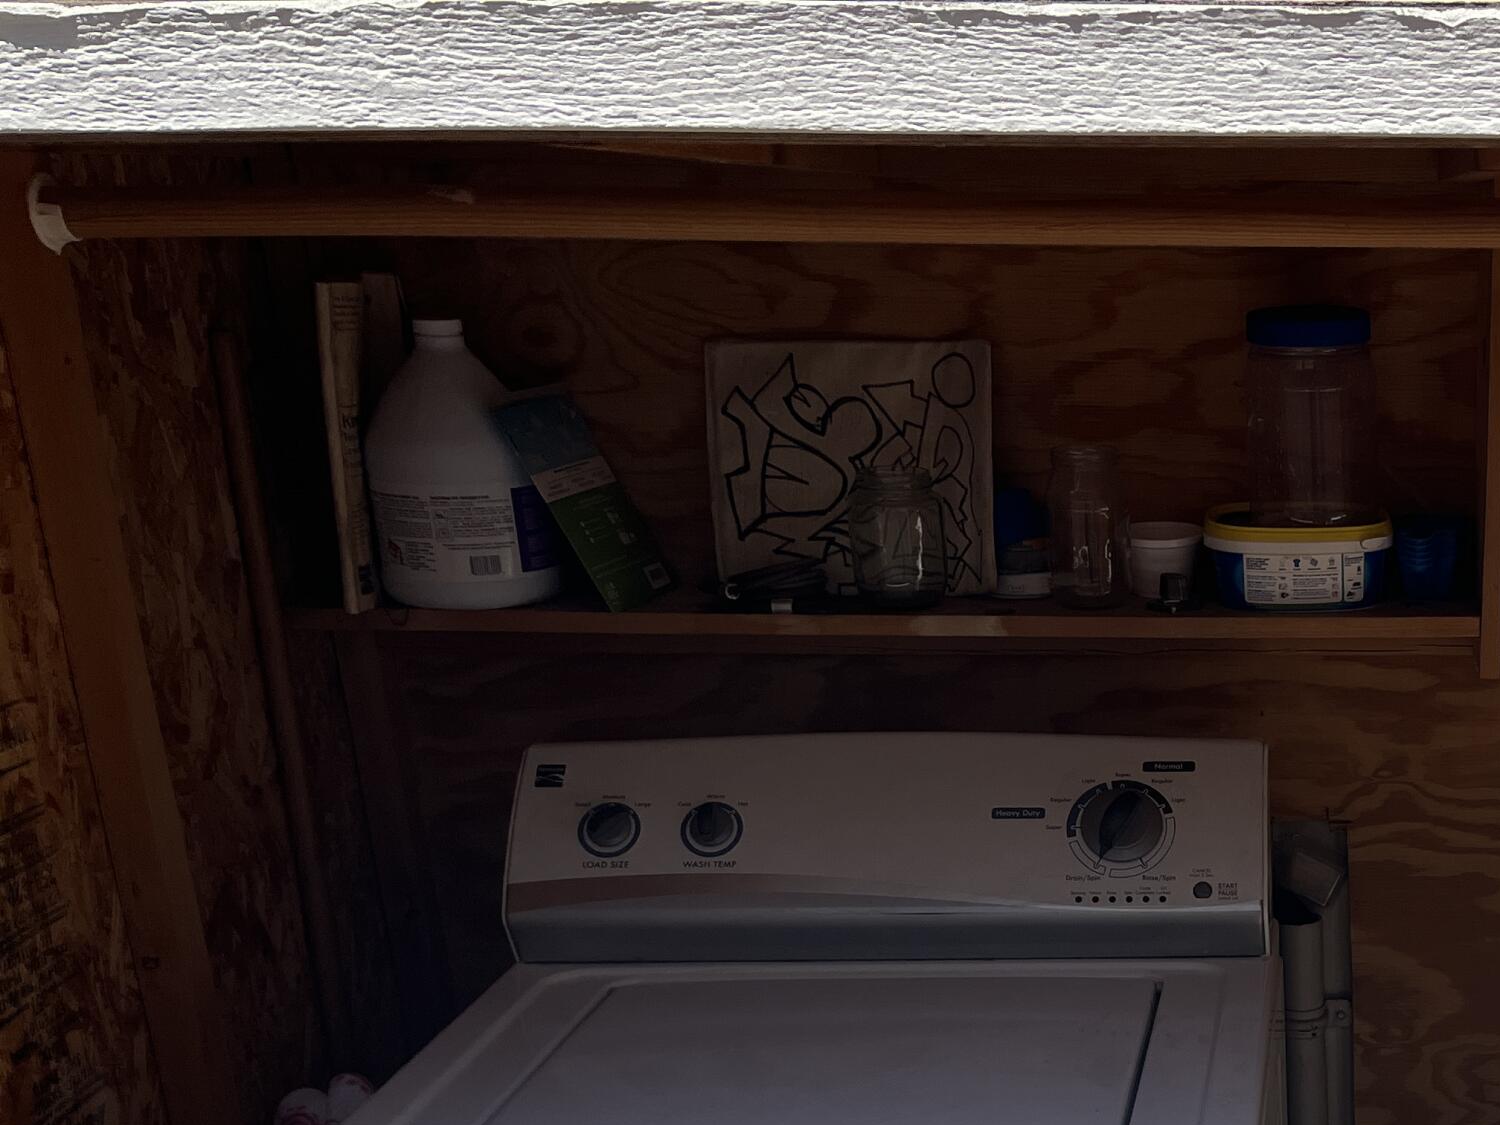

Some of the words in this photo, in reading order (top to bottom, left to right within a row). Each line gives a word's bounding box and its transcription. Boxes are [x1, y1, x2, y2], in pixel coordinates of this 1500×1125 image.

[996, 809, 1020, 818] Heavy
[1022, 809, 1041, 817] Duty
[582, 860, 608, 869] LOAD
[610, 860, 630, 869] SIZE
[683, 860, 711, 869] WASH
[713, 860, 737, 869] TEMP
